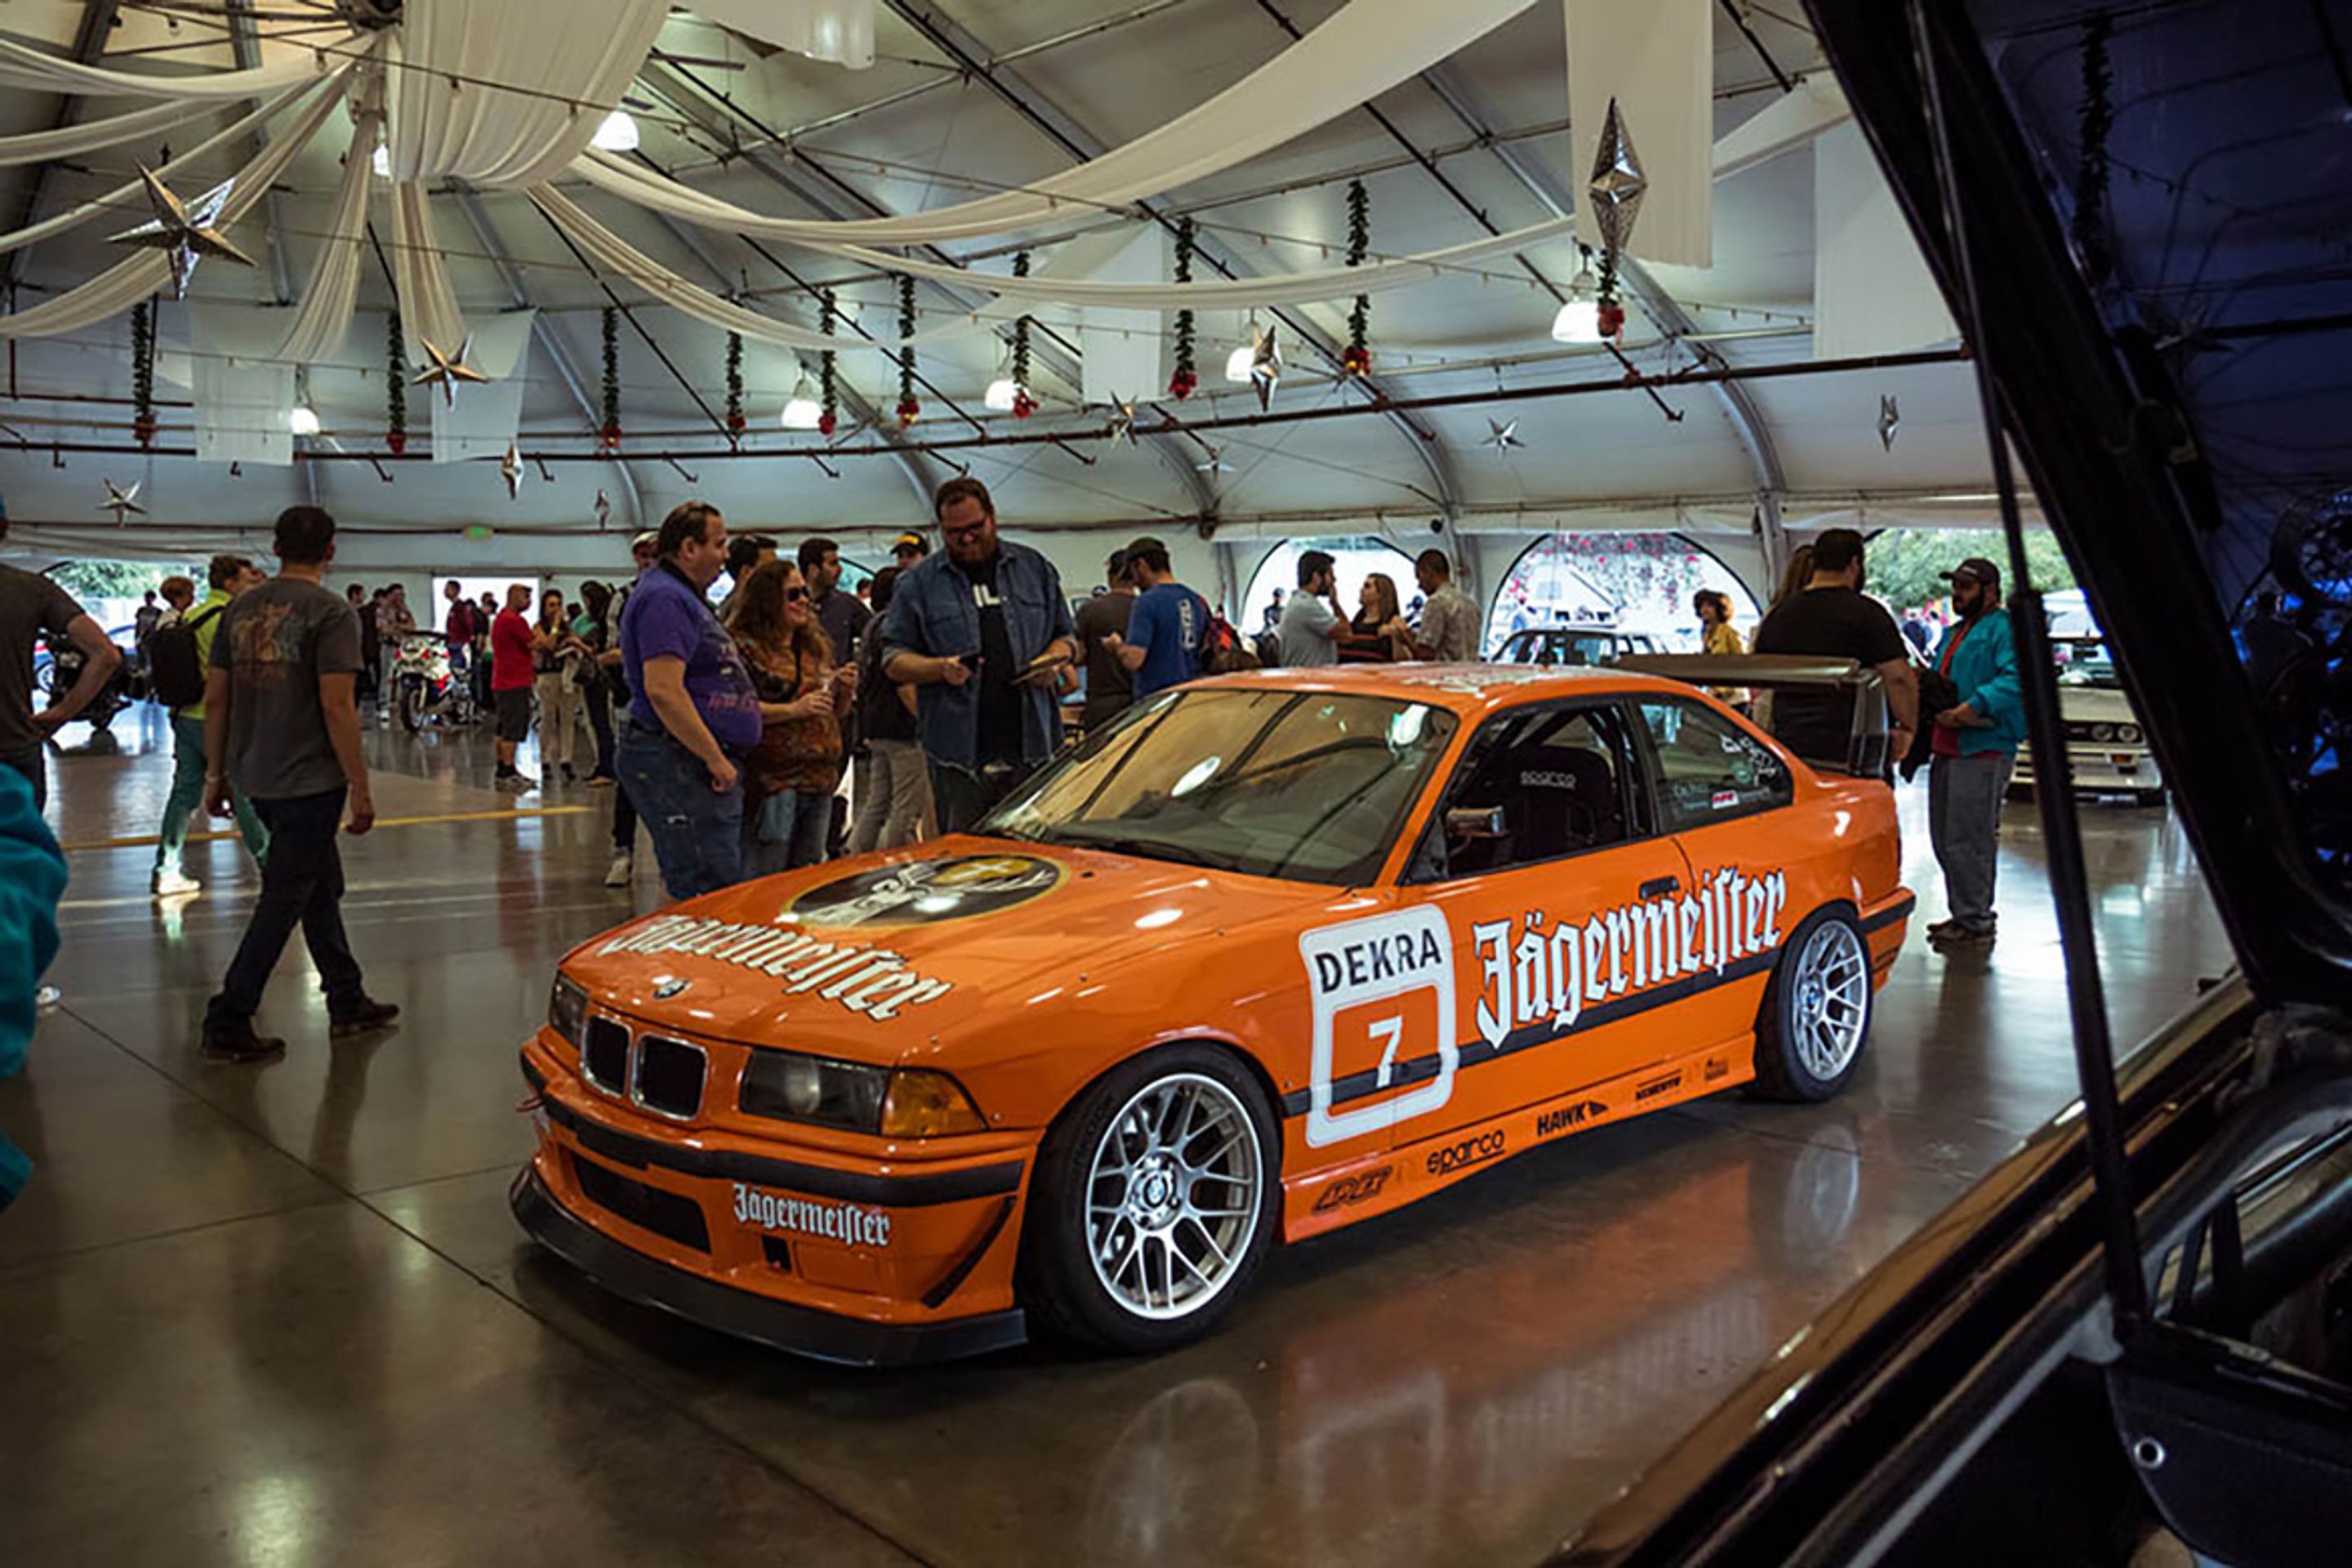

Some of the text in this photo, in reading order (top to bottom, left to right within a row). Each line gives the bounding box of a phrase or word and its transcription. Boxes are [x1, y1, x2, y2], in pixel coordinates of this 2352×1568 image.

[1315, 928, 1443, 994] DEKRA
[1369, 1015, 1403, 1089] 7
[1537, 1100, 1588, 1136] HAWK
[1427, 1129, 1505, 1176] sparco
